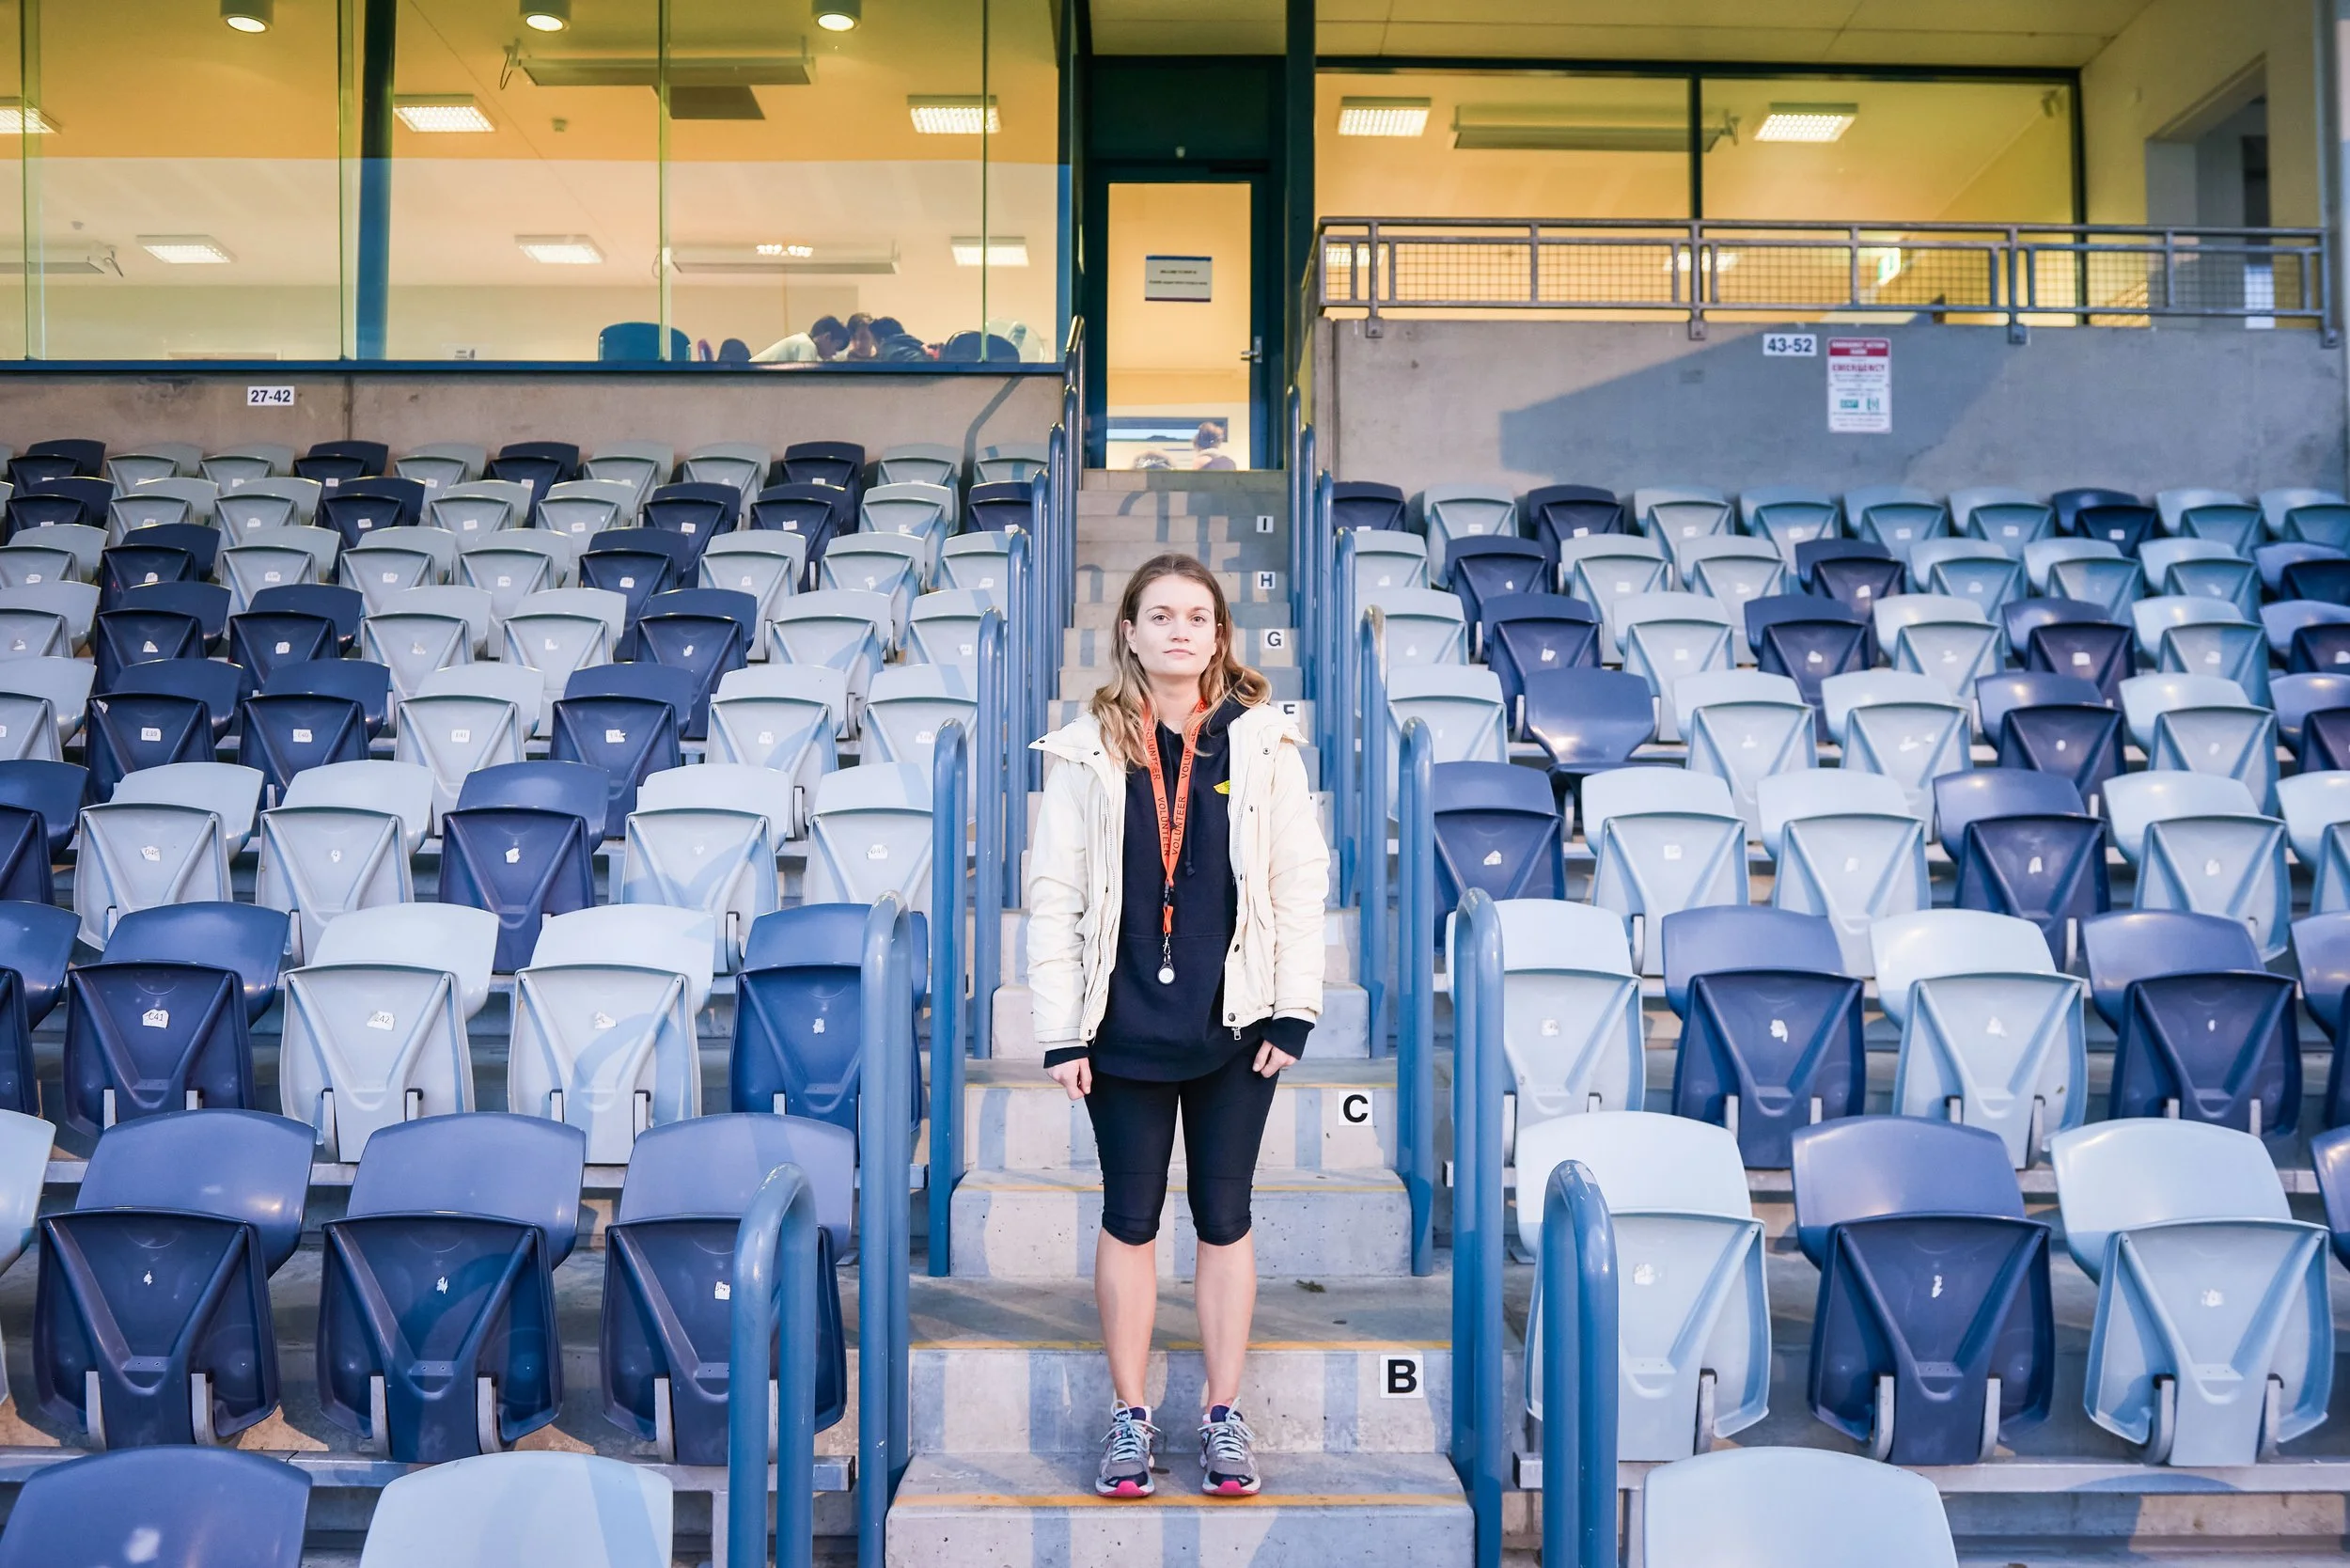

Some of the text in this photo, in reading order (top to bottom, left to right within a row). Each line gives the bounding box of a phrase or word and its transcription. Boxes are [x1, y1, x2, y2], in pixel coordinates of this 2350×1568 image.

[1767, 337, 1812, 353] 43-52
[251, 389, 291, 403] 27-42
[1263, 518, 1267, 531] I
[1261, 573, 1273, 588] H
[1267, 631, 1281, 647] G
[1157, 796, 1171, 856] VOLUNTEER
[1172, 796, 1186, 855] VOLUNTEER
[1343, 1094, 1369, 1123] C
[1387, 1359, 1418, 1394] B
